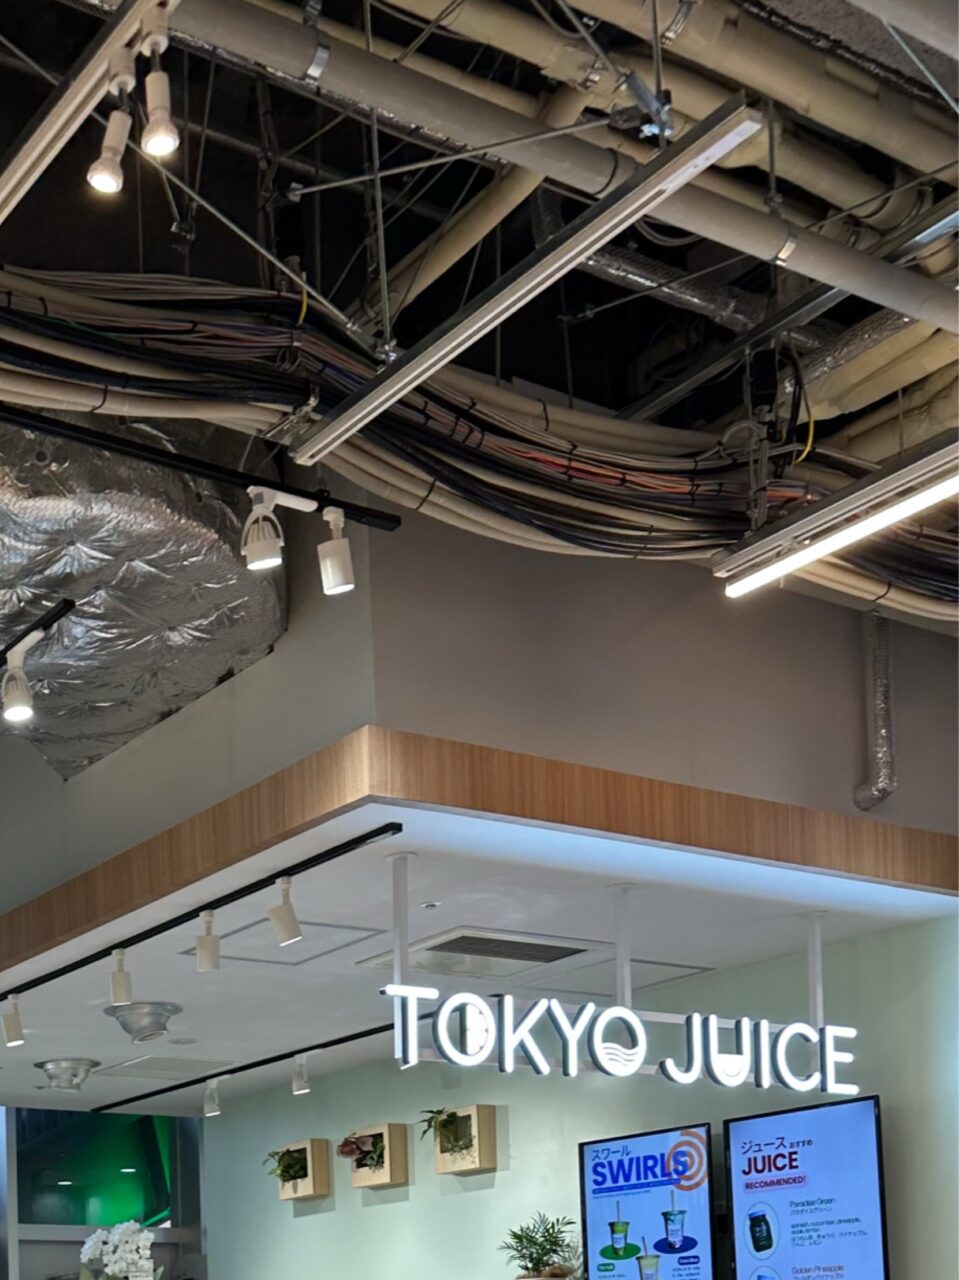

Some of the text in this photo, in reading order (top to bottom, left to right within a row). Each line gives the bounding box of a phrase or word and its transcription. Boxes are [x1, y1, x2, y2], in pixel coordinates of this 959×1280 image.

[381, 984, 860, 1095] TOKYO JUICE
[591, 1145, 632, 1162] スワール
[741, 1137, 787, 1156] ジュース
[591, 1150, 689, 1187] SWIRLS
[742, 1151, 800, 1176] JUICE
[744, 1175, 807, 1190] RECOMMENDED!
